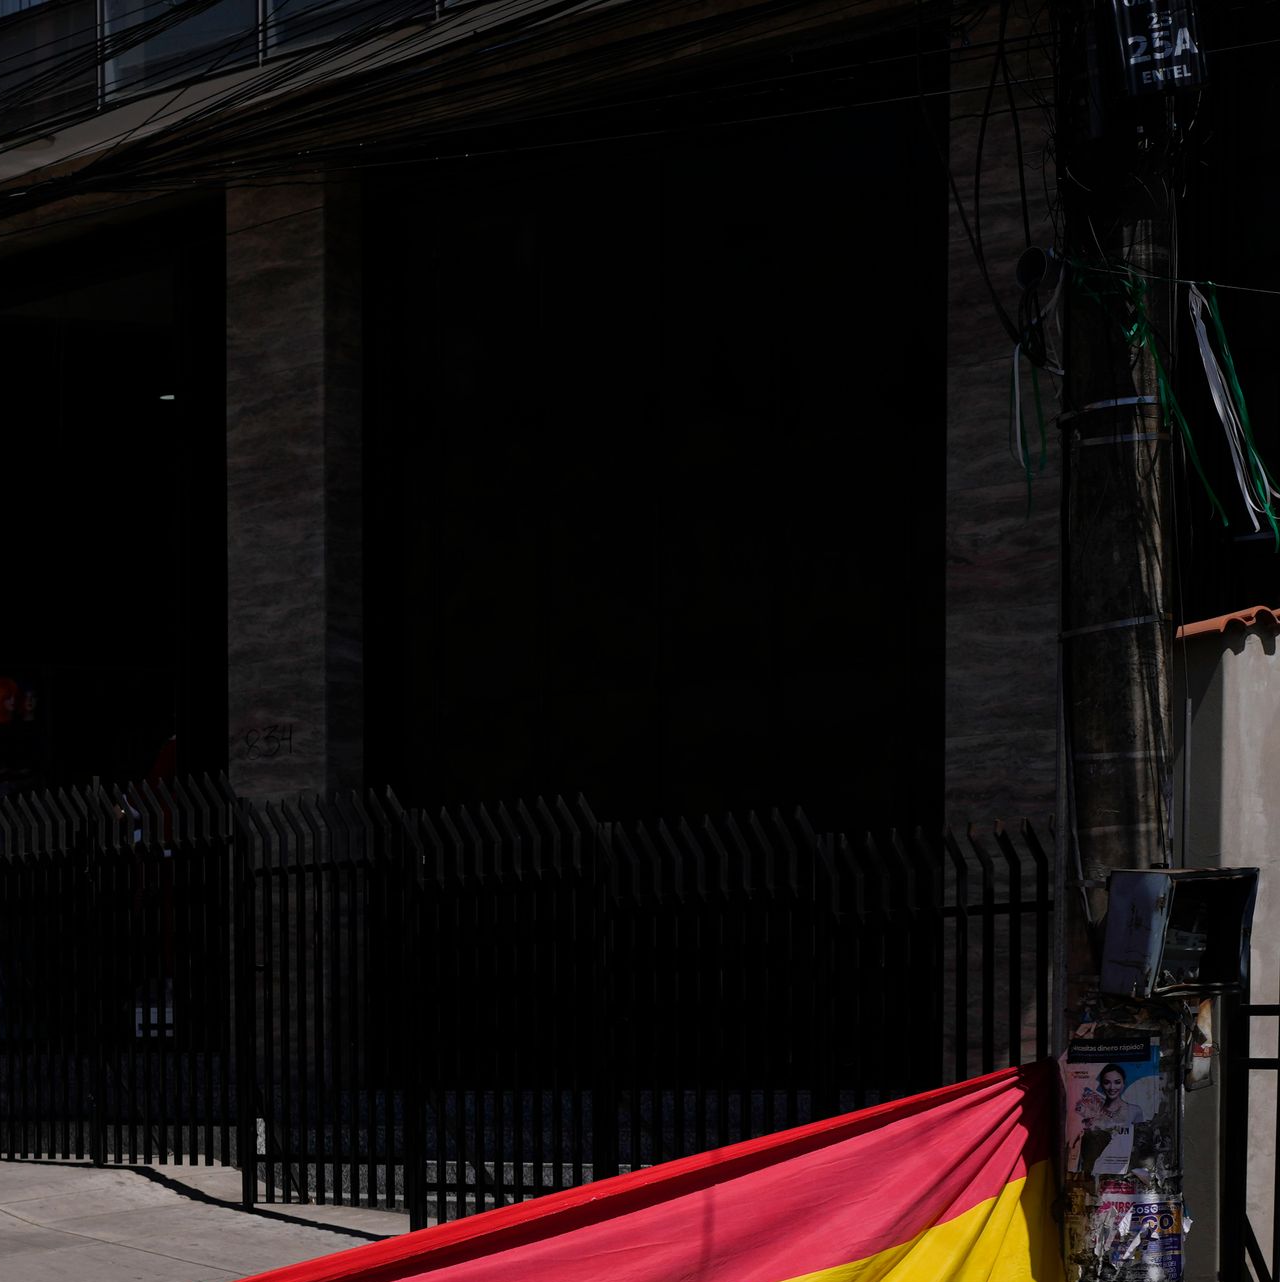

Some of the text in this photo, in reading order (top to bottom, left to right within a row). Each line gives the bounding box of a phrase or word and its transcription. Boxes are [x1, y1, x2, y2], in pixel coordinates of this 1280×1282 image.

[1127, 26, 1200, 66] 25A
[1142, 64, 1193, 85] ENTEL
[1097, 1044, 1119, 1052] dinero
